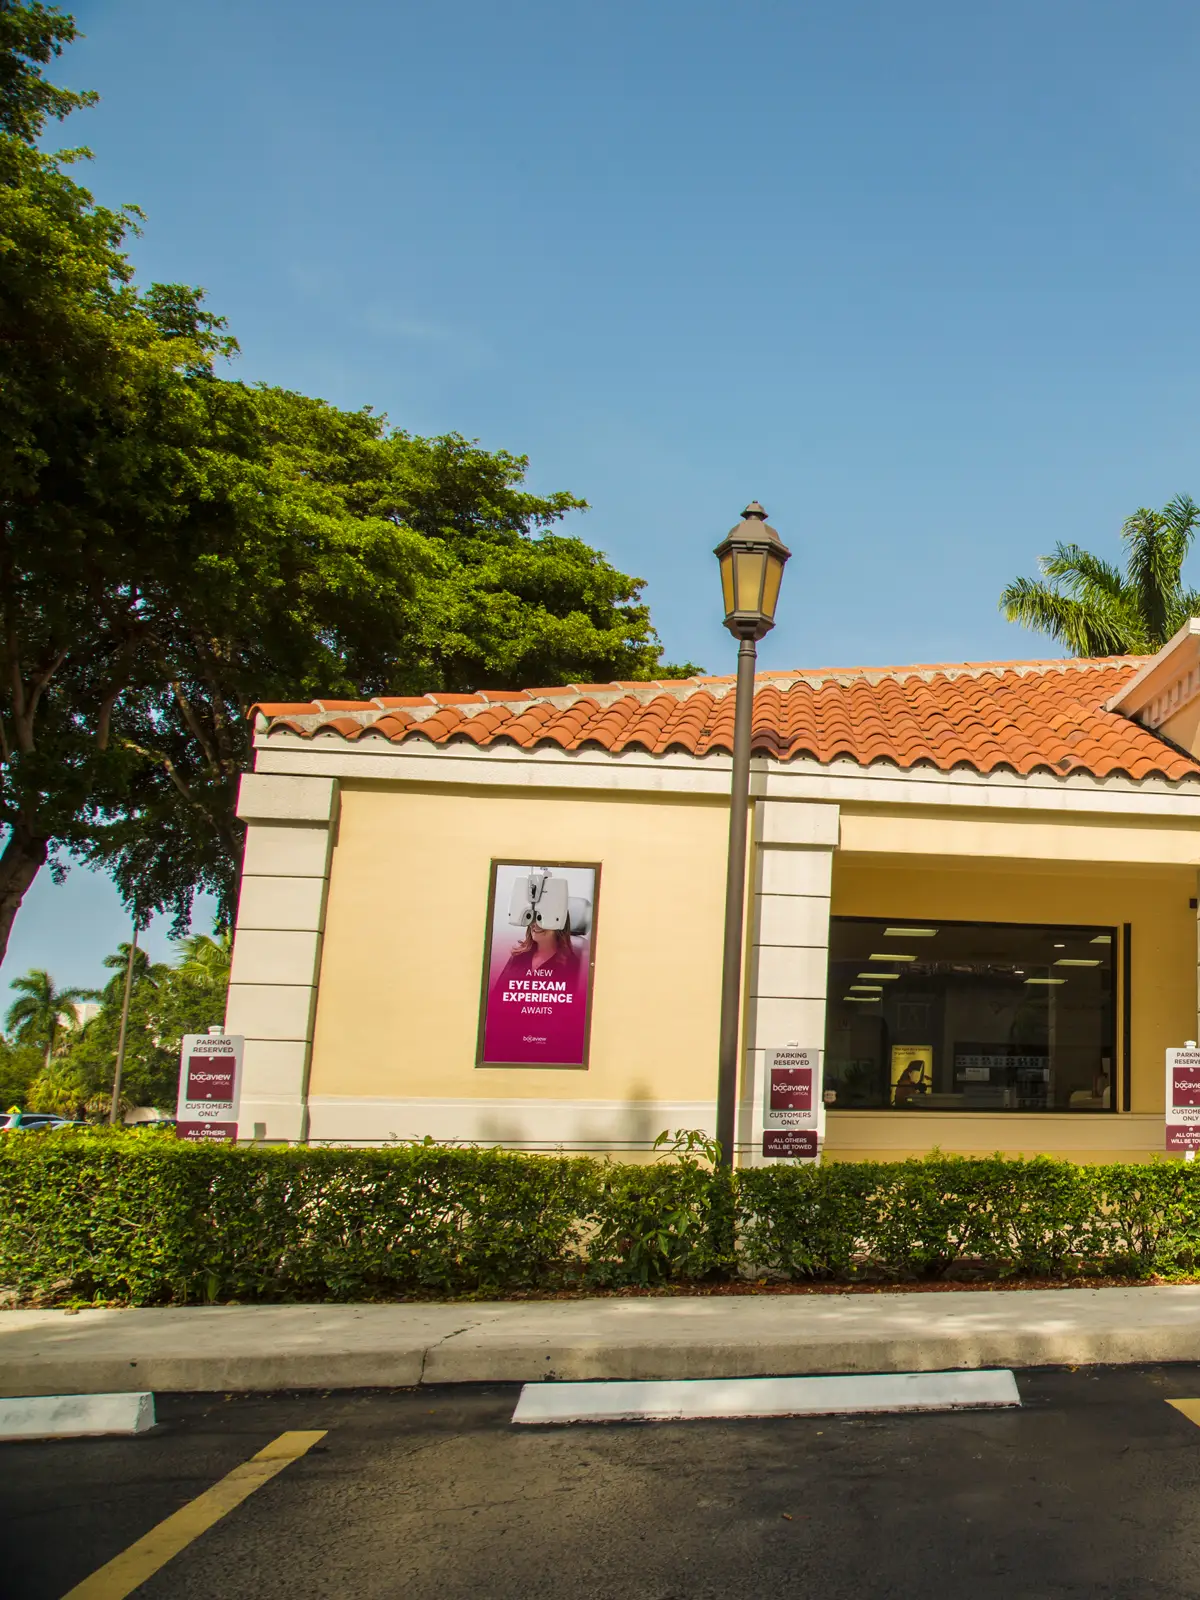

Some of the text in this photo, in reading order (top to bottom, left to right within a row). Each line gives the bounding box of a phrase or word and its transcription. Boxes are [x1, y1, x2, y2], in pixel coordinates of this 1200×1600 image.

[509, 980, 566, 991] EYE EXAM
[503, 992, 572, 1003] EXPERIENCE
[190, 1072, 231, 1082] bocaview
[773, 1084, 809, 1093] bocaview
